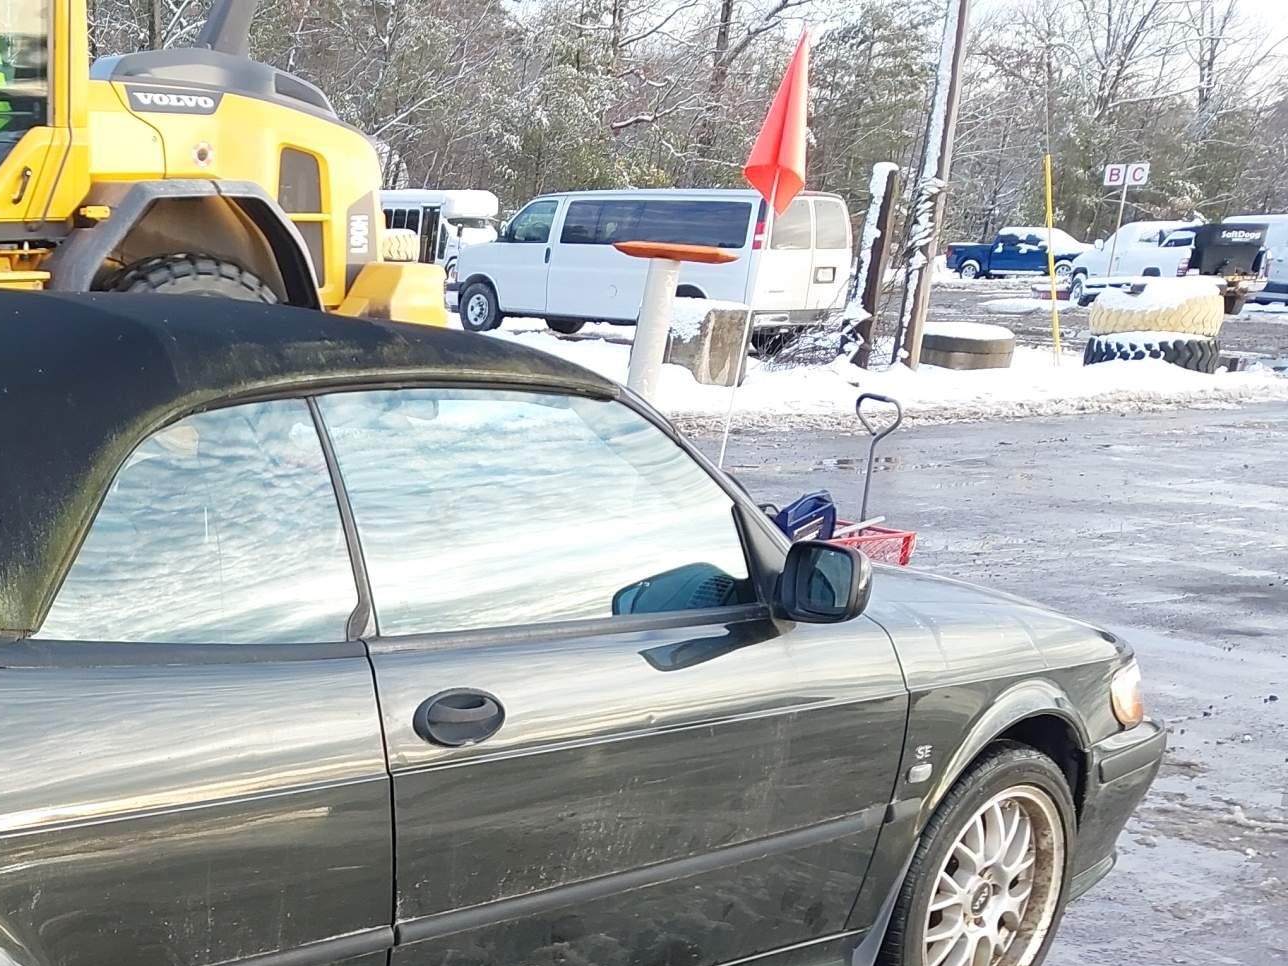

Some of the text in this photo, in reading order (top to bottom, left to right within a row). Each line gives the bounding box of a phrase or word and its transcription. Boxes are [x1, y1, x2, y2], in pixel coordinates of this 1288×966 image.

[132, 92, 215, 108] VOLVO
[1109, 167, 1121, 182] B
[1132, 166, 1145, 182] C
[349, 214, 369, 254] L90H
[914, 744, 933, 760] SE
